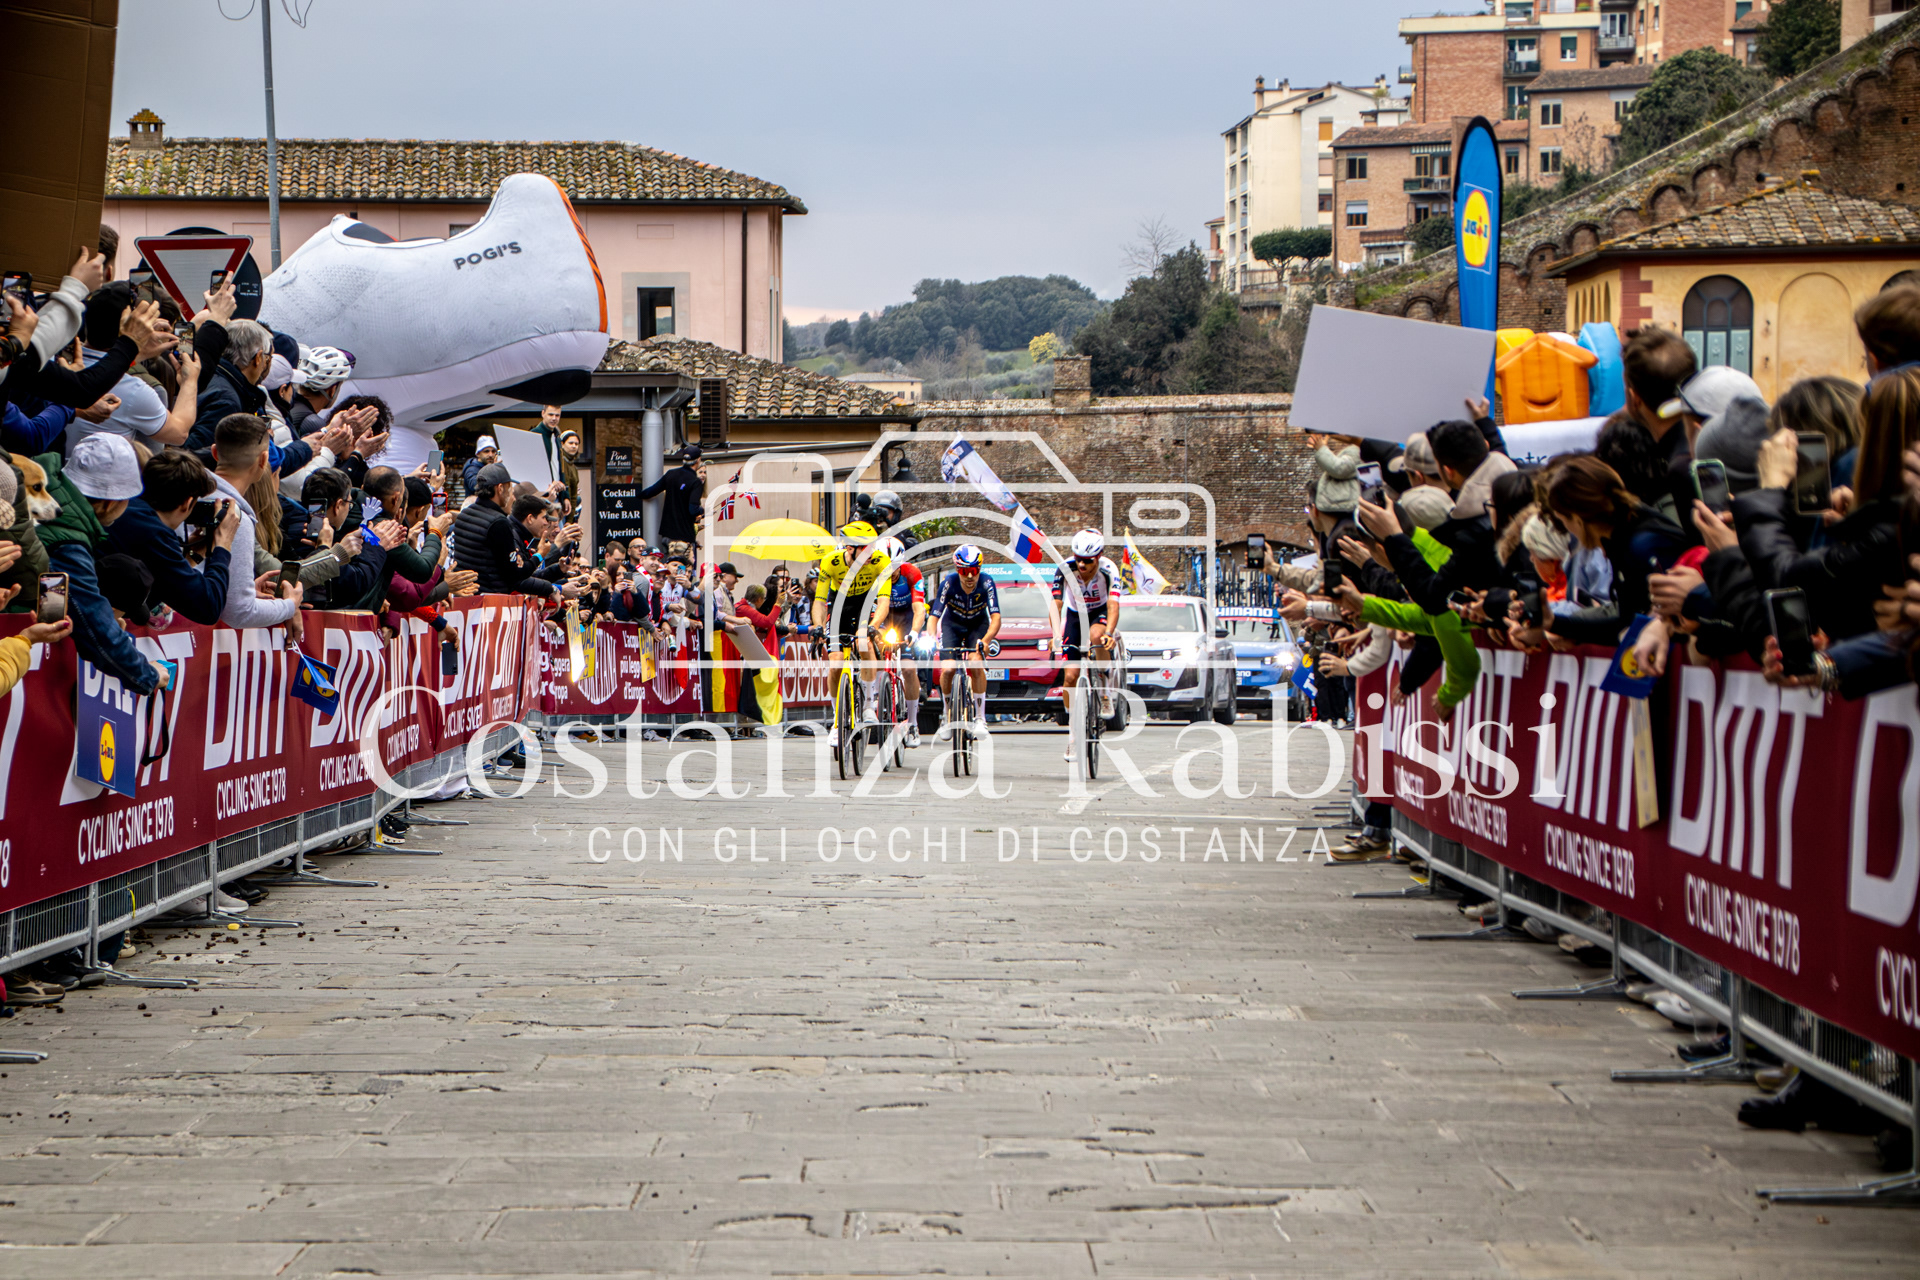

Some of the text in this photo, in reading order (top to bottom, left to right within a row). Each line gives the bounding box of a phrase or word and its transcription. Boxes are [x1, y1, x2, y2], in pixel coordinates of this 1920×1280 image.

[453, 241, 522, 270] POGI'S
[602, 488, 637, 498] Cocktail
[615, 500, 624, 509] &
[598, 511, 641, 520] Wine BAR
[606, 528, 642, 539] Aperitivi
[203, 627, 290, 771] DMT
[623, 681, 646, 700] d'Europa
[320, 754, 347, 792] CYCLING
[346, 751, 363, 785] SINCE
[1668, 664, 1825, 891] DMT
[216, 766, 287, 820] CYCLING SINCE 1978
[78, 795, 175, 866] CYCLING SINCE 1978
[1544, 822, 1636, 899] CYCLING SINCE 1978
[1685, 871, 1801, 976] CYCLING SINCE 1978
